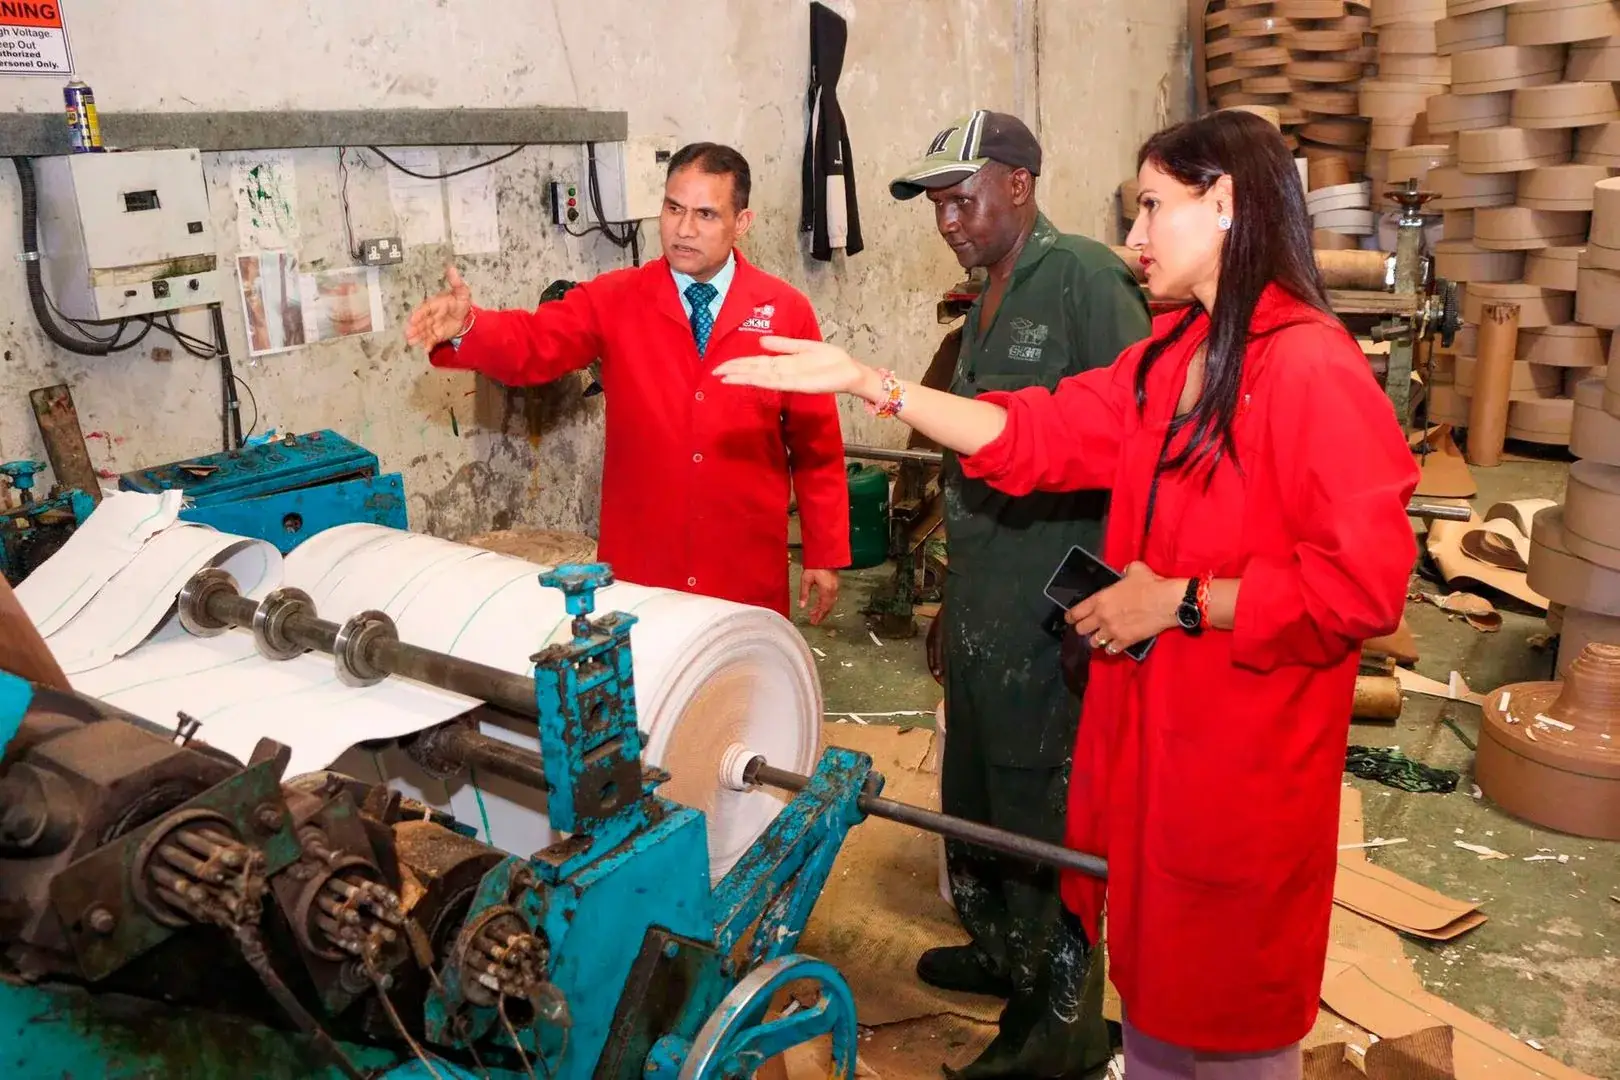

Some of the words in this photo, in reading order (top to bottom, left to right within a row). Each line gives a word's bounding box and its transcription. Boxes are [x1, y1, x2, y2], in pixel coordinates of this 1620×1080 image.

[0, 2, 55, 20] NING
[18, 41, 36, 49] Out
[36, 60, 59, 69] Only.
